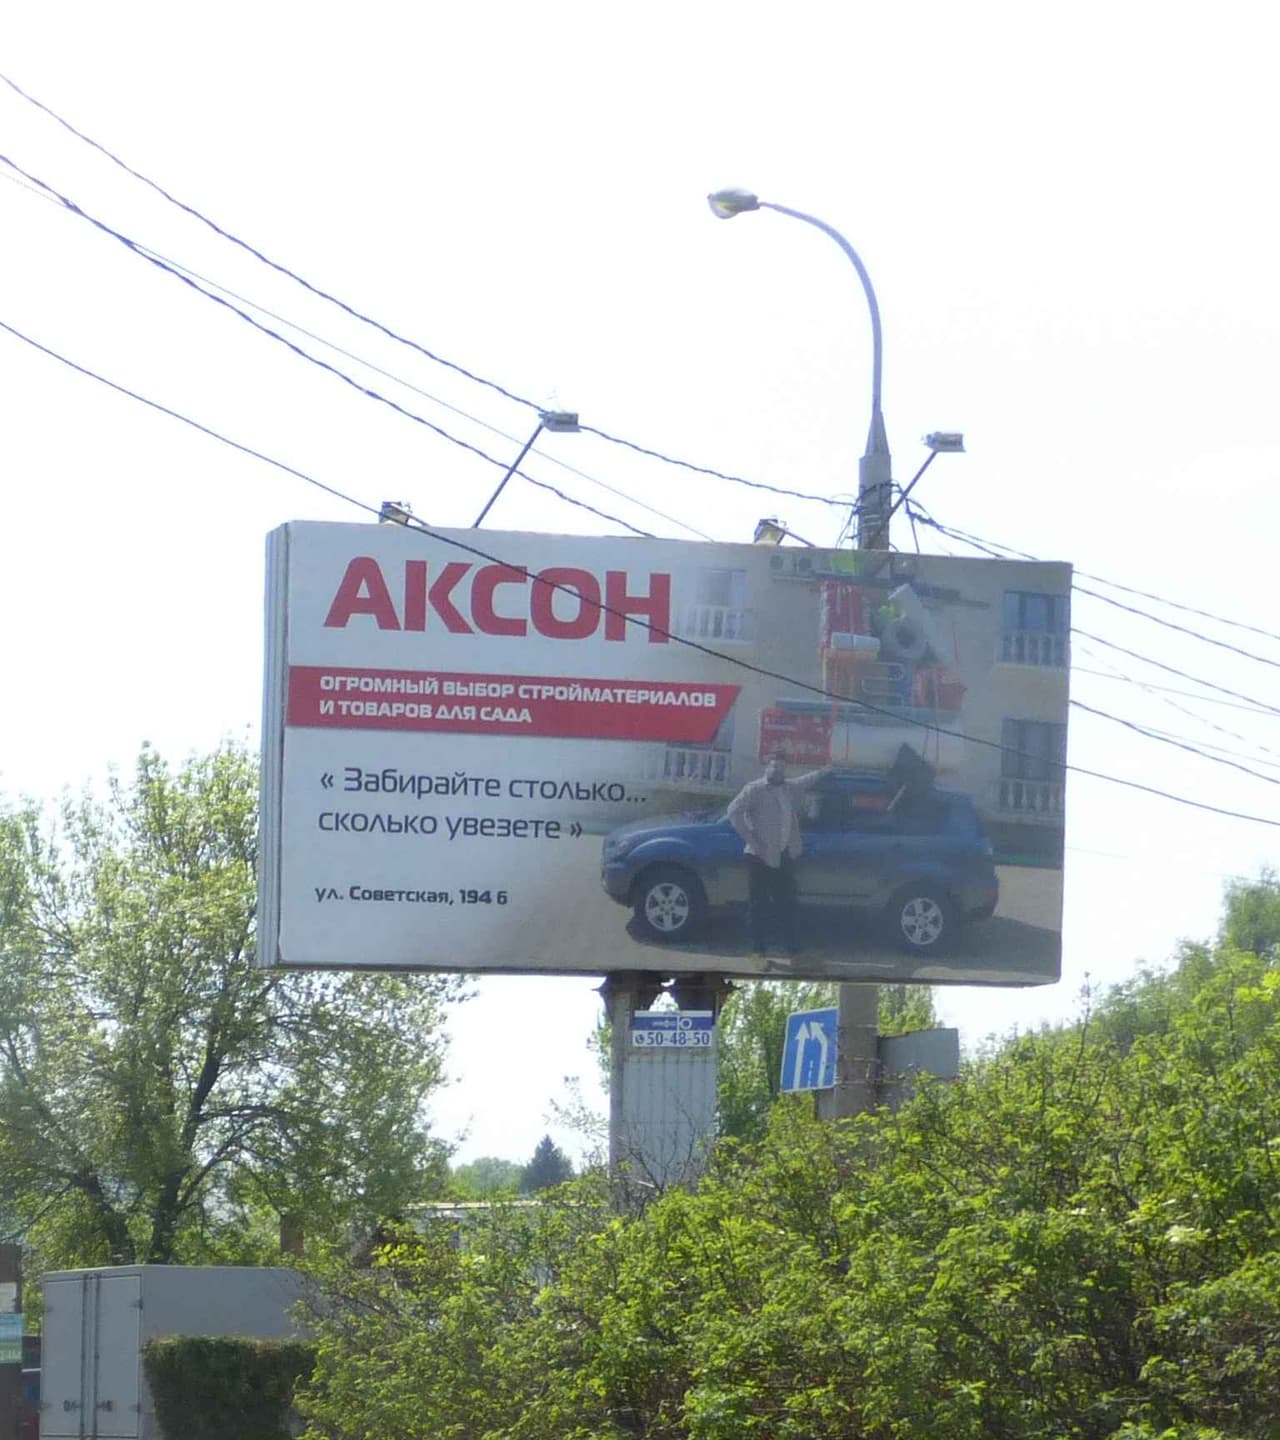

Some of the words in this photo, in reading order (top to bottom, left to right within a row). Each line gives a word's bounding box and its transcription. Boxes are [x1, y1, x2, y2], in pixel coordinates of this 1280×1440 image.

[323, 556, 671, 644] АКСОН
[319, 675, 438, 695] ОГРОМНЫЙ
[442, 681, 514, 698] ВЫБОР
[518, 684, 716, 708] СТРОЙМАТЕРИАЛОВ
[319, 700, 334, 715] И
[338, 701, 432, 718] ТОВАРОВ
[435, 706, 476, 721] ДЛЯ
[480, 707, 532, 723] САДА
[344, 767, 501, 800] Забирайте
[509, 779, 647, 802] столько...
[318, 812, 438, 835] сколько
[444, 816, 561, 840] увезете
[315, 887, 344, 902] ул.
[349, 885, 454, 906] Советская,
[459, 889, 492, 904] 194
[646, 1031, 710, 1046] 50-48-50
